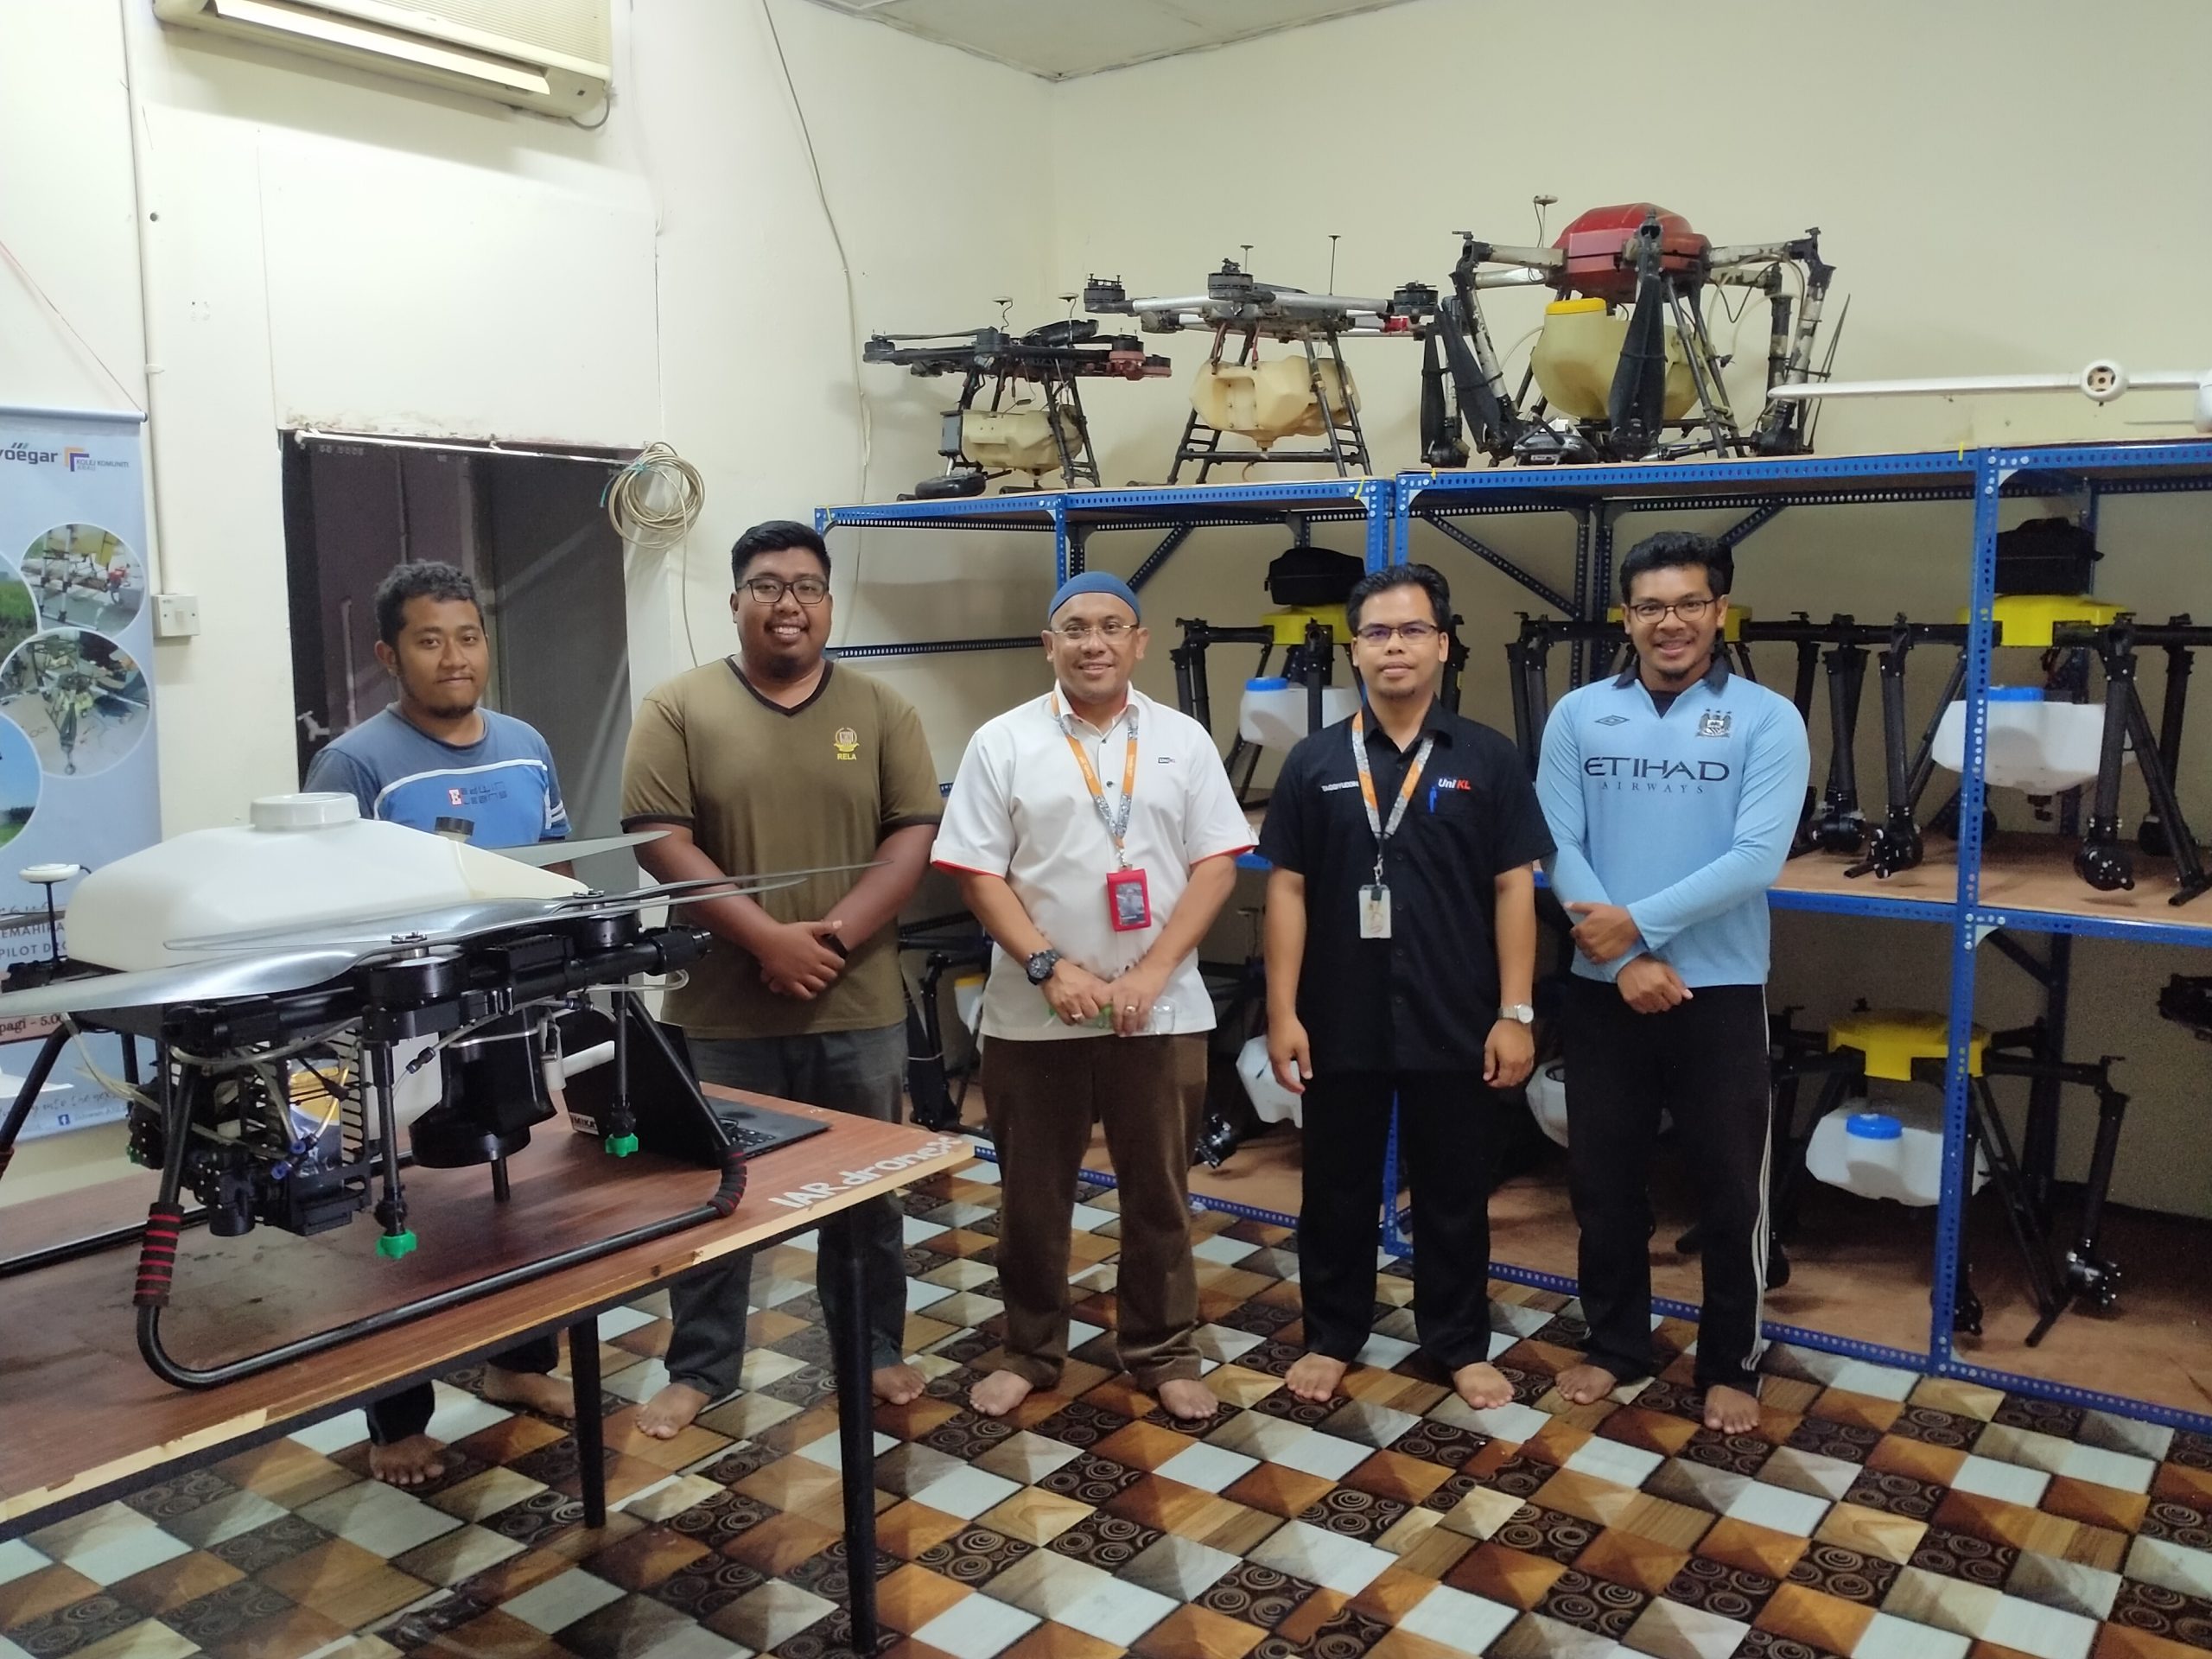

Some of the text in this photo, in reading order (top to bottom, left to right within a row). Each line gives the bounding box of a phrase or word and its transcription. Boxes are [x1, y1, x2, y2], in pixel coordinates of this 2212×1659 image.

[76, 458, 96, 467] KOLEJ
[1583, 756, 1730, 782] ETIHAD
[1601, 781, 1704, 794] AIRWAYS
[0, 1018, 26, 1035] pagi
